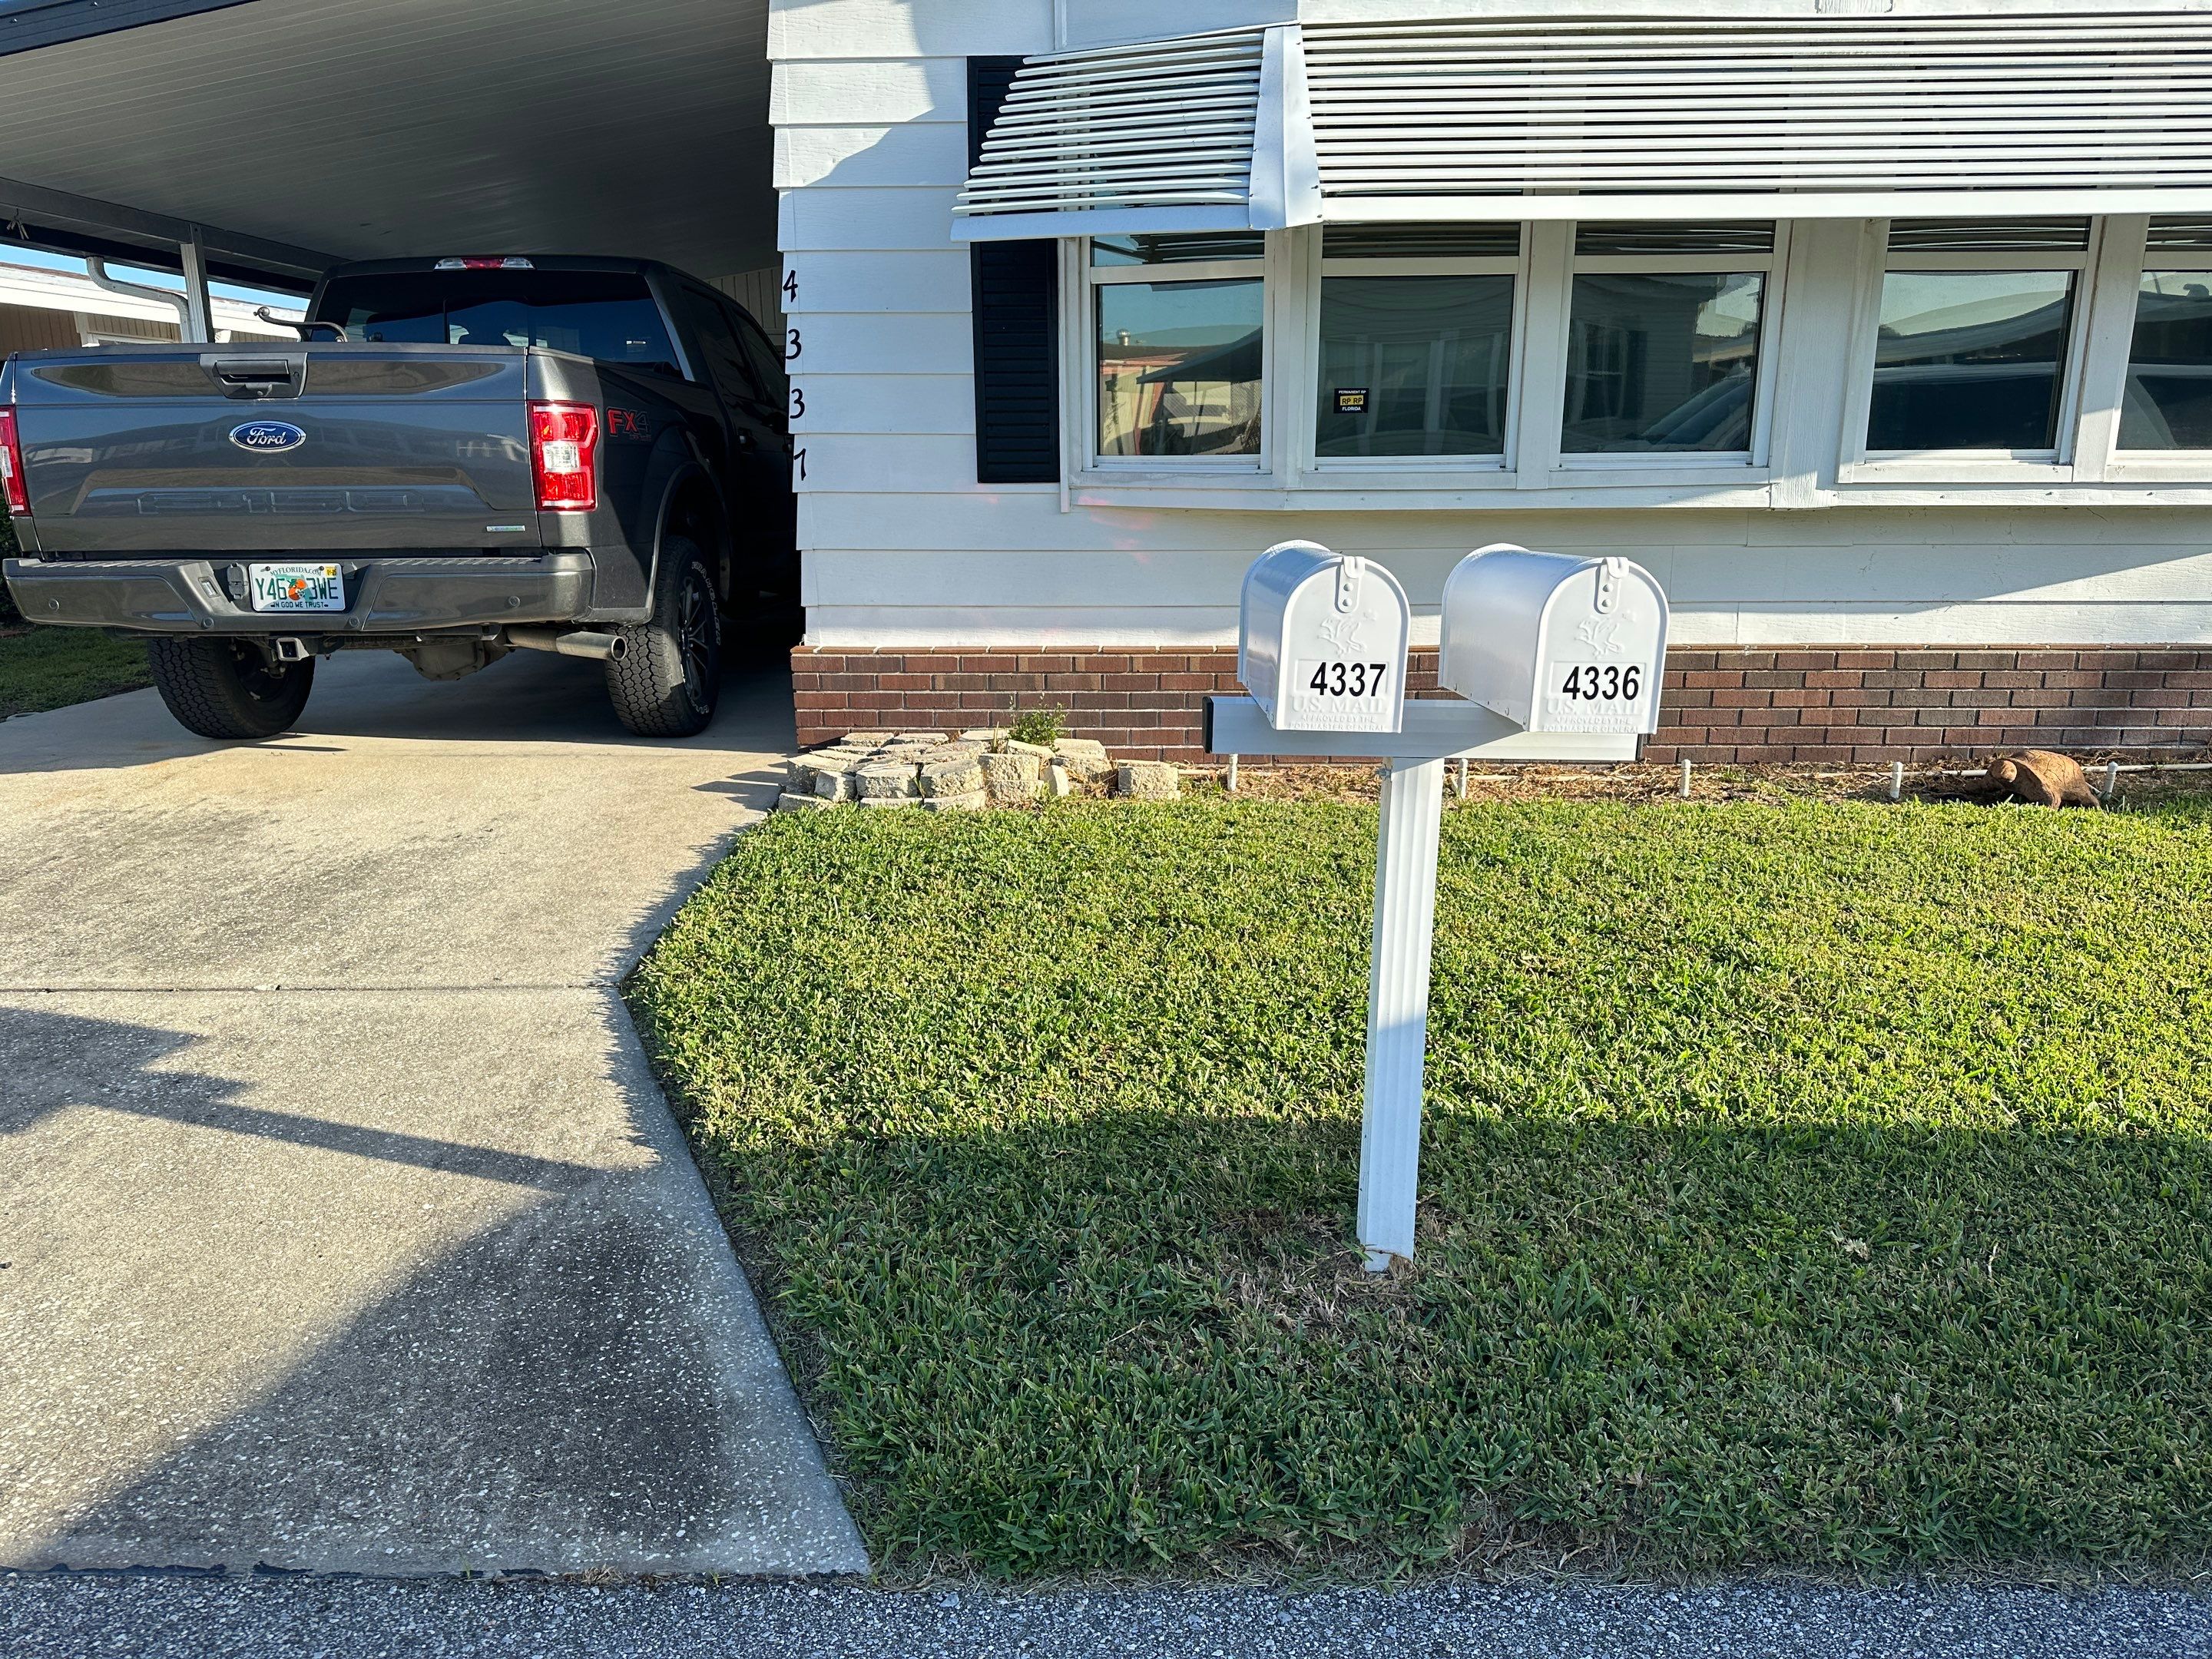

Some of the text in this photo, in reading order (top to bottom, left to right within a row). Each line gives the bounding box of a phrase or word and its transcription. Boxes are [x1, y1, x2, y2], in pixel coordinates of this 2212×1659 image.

[606, 406, 651, 438] FX4
[247, 427, 286, 445] Ford
[270, 567, 322, 576] MYFLORIDA.COM
[255, 578, 339, 600] Y46 3WE
[1310, 662, 1386, 697] 4337
[1562, 666, 1641, 700] 4336
[1290, 694, 1387, 715] U.S. MAIL
[1545, 697, 1642, 717] U.S. MAIL
[1301, 714, 1346, 724] APPROVED
[1359, 714, 1377, 724] THE
